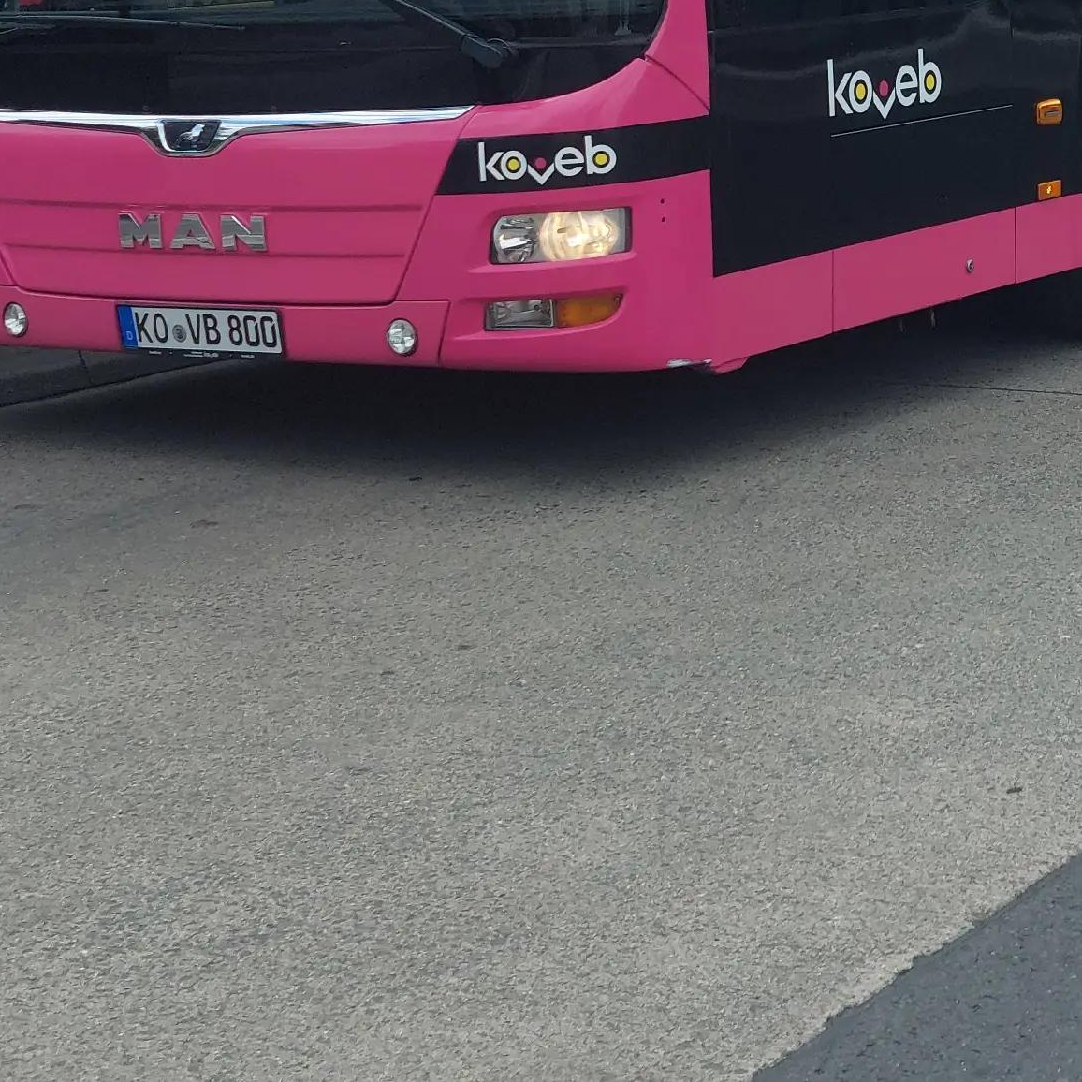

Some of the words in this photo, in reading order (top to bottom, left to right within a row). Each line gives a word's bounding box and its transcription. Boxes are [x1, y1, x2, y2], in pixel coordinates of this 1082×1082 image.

[827, 48, 942, 119] koveb
[478, 135, 617, 185] koveb
[118, 212, 267, 251] MAN
[135, 312, 168, 344] KO
[185, 313, 222, 345] VB
[227, 314, 278, 348] 800
